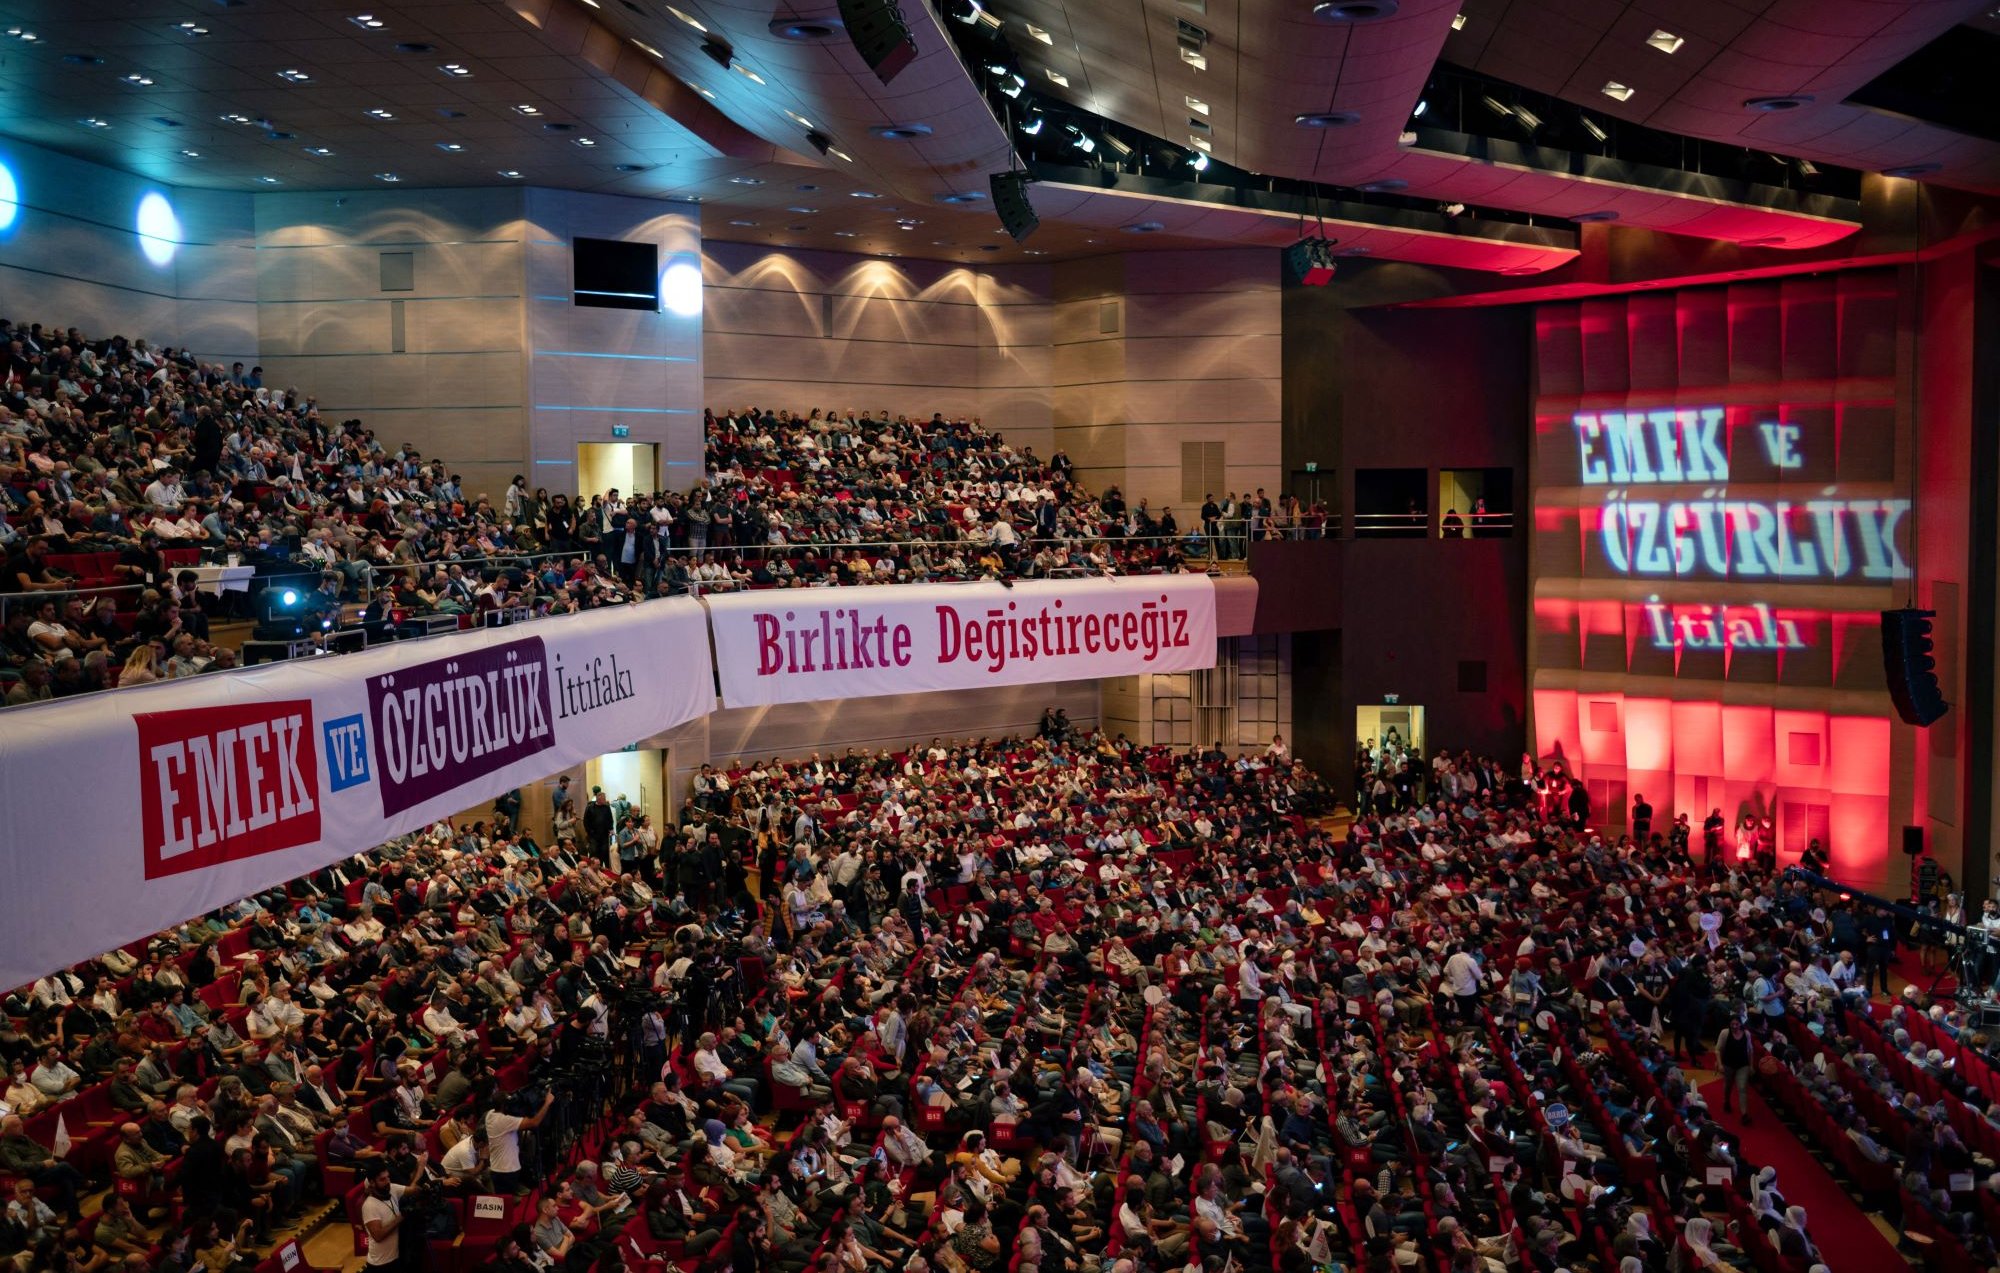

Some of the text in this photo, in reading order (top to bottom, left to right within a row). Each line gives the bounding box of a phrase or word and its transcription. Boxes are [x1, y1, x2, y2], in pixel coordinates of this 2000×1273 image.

[1573, 408, 1801, 484] EMEK VE
[753, 594, 1190, 676] Birlikte Değiştireceğiz
[151, 650, 636, 861] EMEK VE ÖZGÜRLÜK İttifakı
[476, 1202, 503, 1212] BASIN
